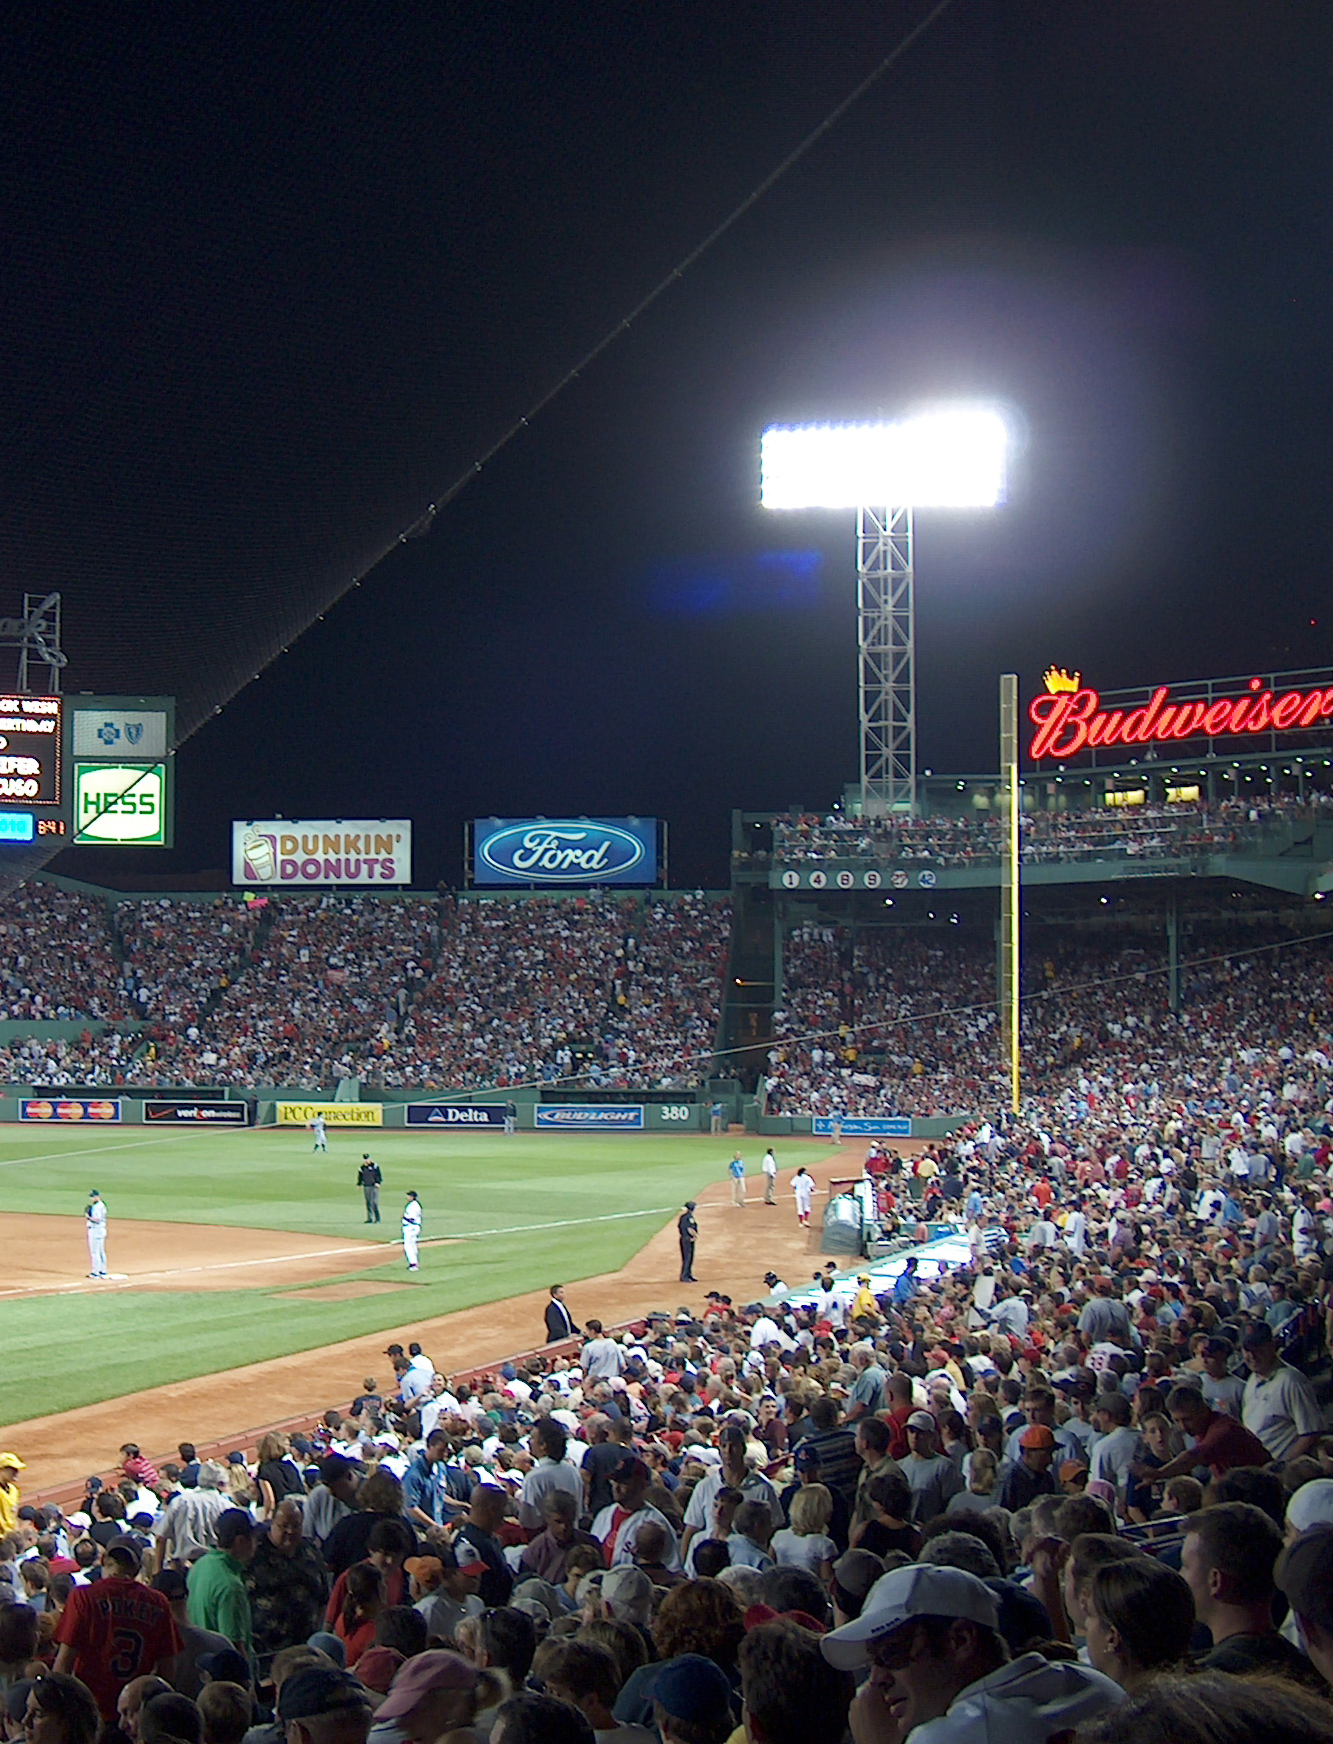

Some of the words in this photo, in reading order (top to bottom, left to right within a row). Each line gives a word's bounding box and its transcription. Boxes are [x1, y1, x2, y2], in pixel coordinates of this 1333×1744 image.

[1028, 676, 1333, 760] Budweiser
[83, 792, 155, 815] HESS
[280, 833, 401, 855] DUNKIN'
[512, 830, 612, 871] Ford
[280, 858, 396, 880] DONUTS
[813, 874, 822, 886] 4
[920, 873, 934, 886] 42
[176, 1107, 216, 1119] verizon
[283, 1106, 300, 1121] PC
[447, 1108, 489, 1122] Delta
[553, 1112, 589, 1121] BUD
[589, 1112, 639, 1121] LIGHT
[660, 1105, 690, 1121] 380
[110, 1627, 144, 1680] 3
